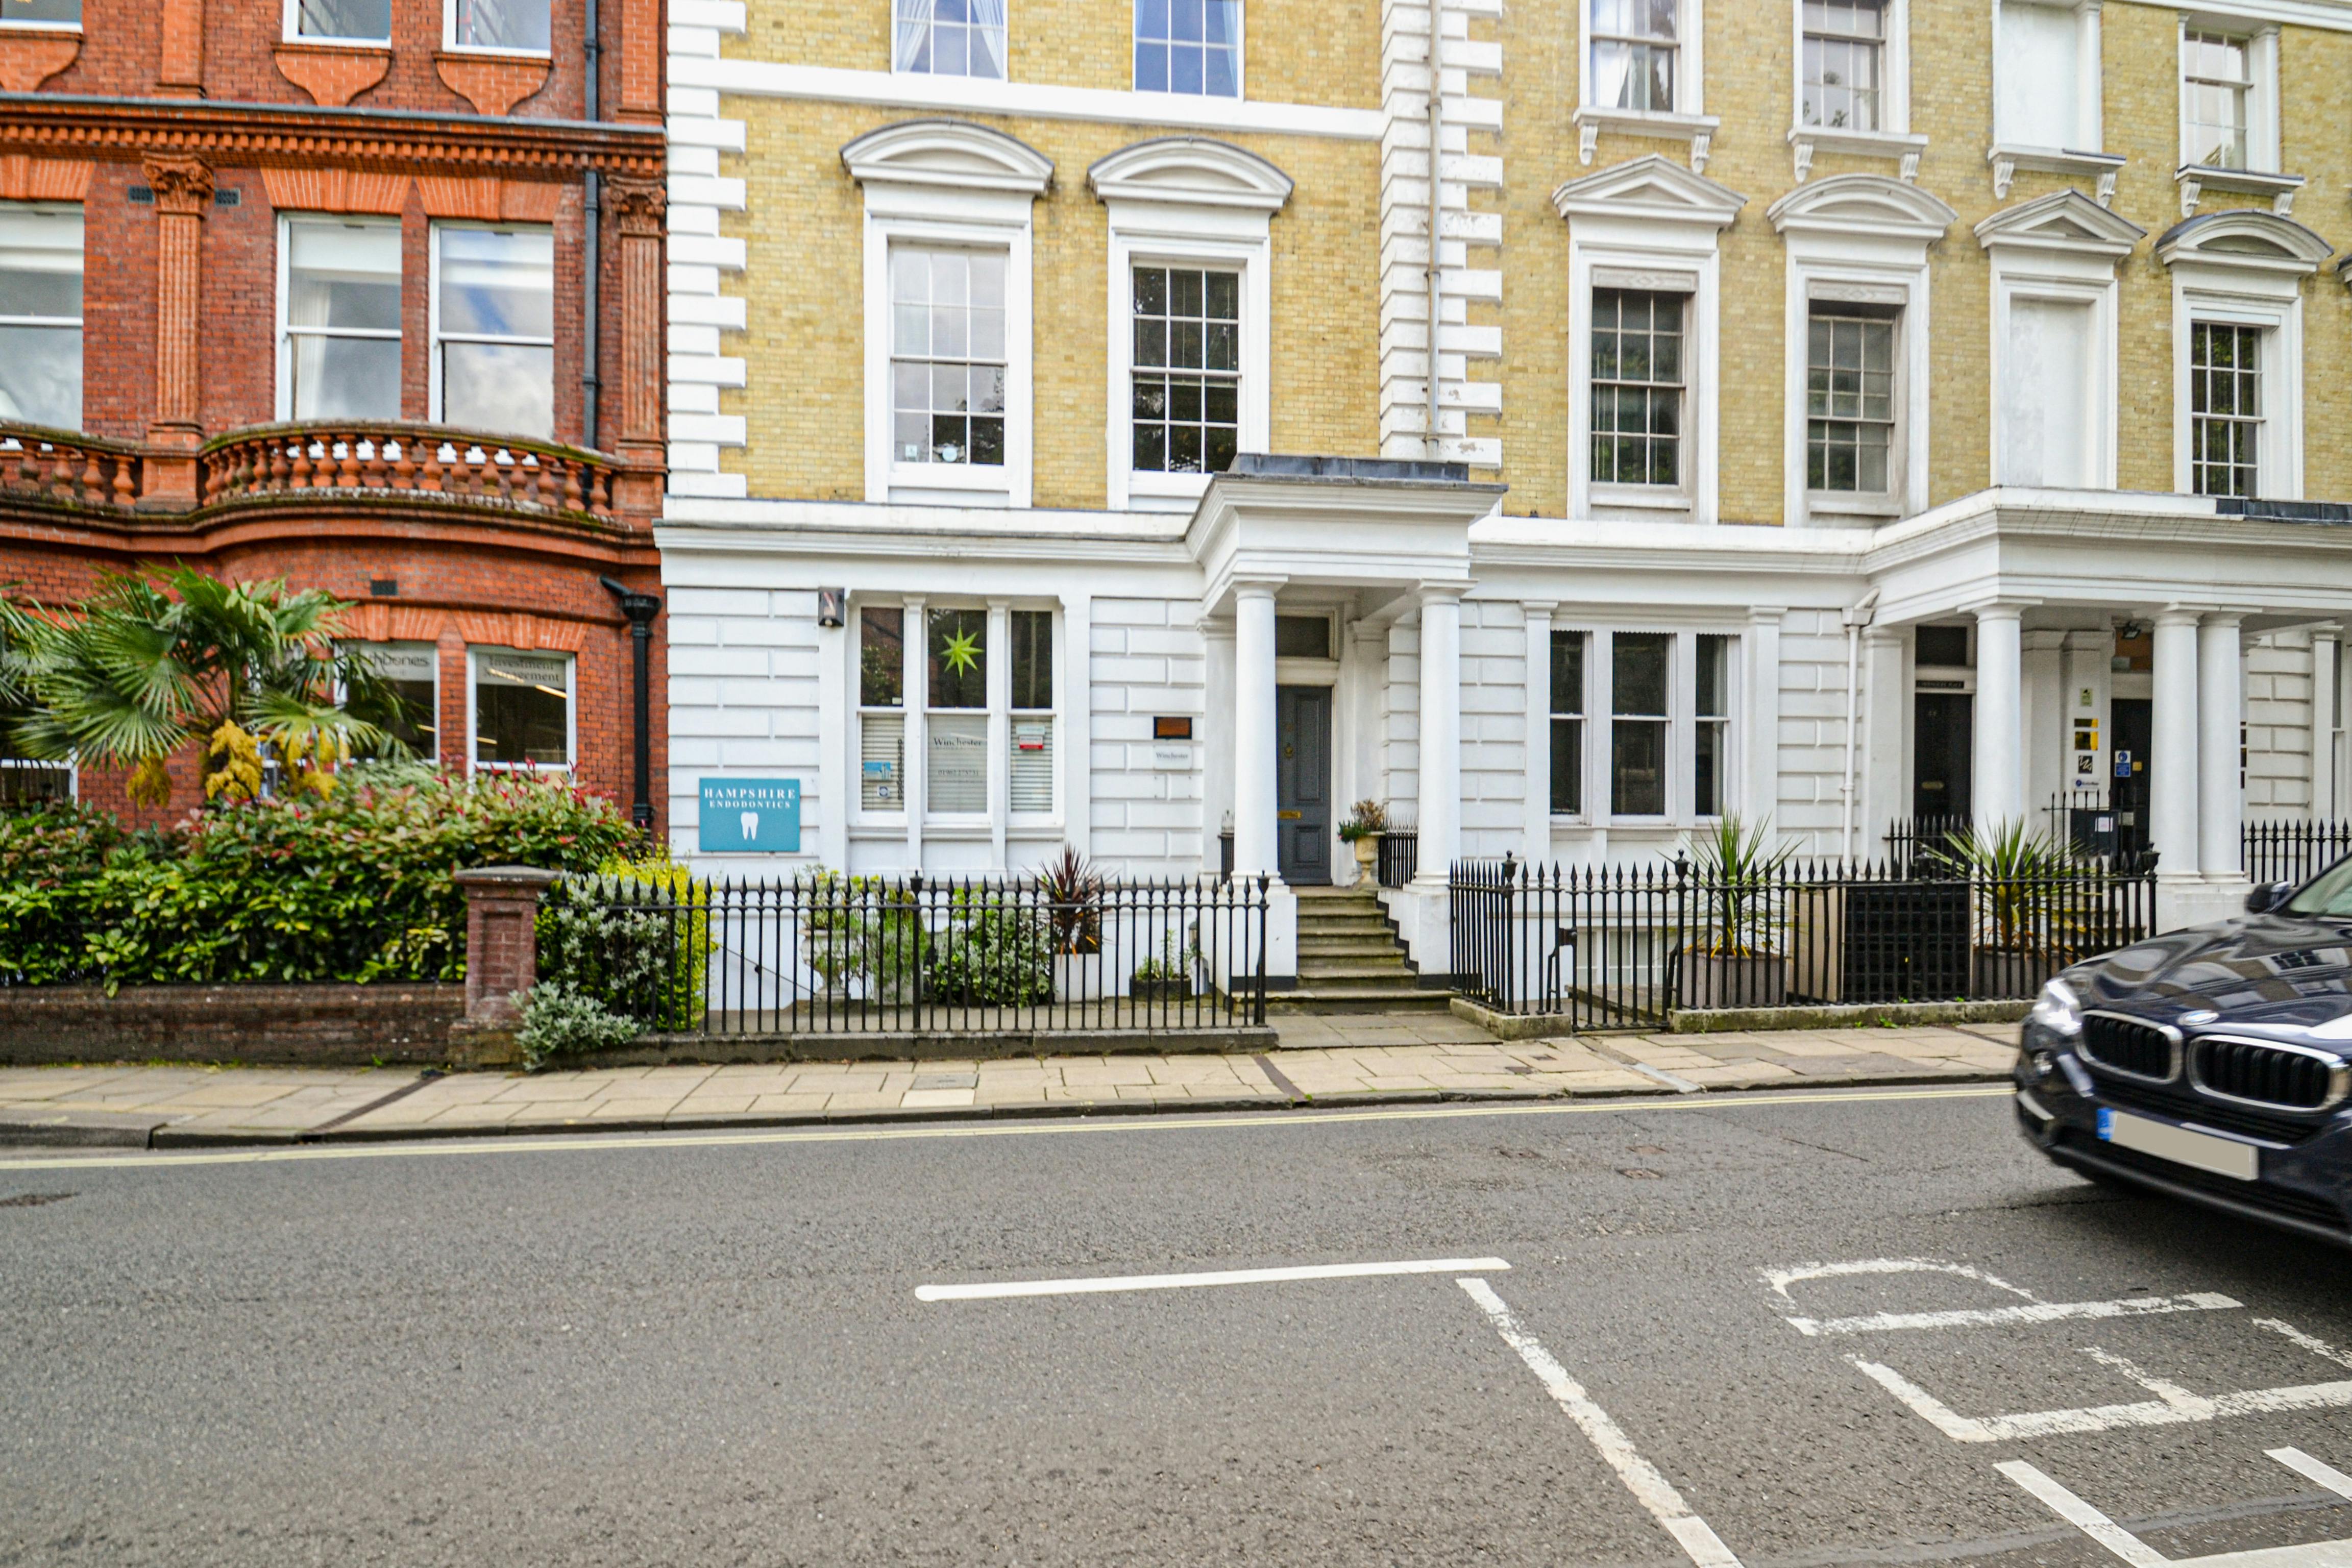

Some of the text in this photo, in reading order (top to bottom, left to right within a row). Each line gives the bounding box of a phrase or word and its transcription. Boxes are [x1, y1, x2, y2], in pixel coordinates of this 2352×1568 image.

[489, 654, 554, 670] Investment
[484, 666, 559, 682] Mgement
[934, 737, 982, 746] Winchester
[704, 788, 796, 799] HAMPSHIRE
[709, 800, 791, 808] ENDODONTICS
[1757, 1256, 2352, 1568] EEP
